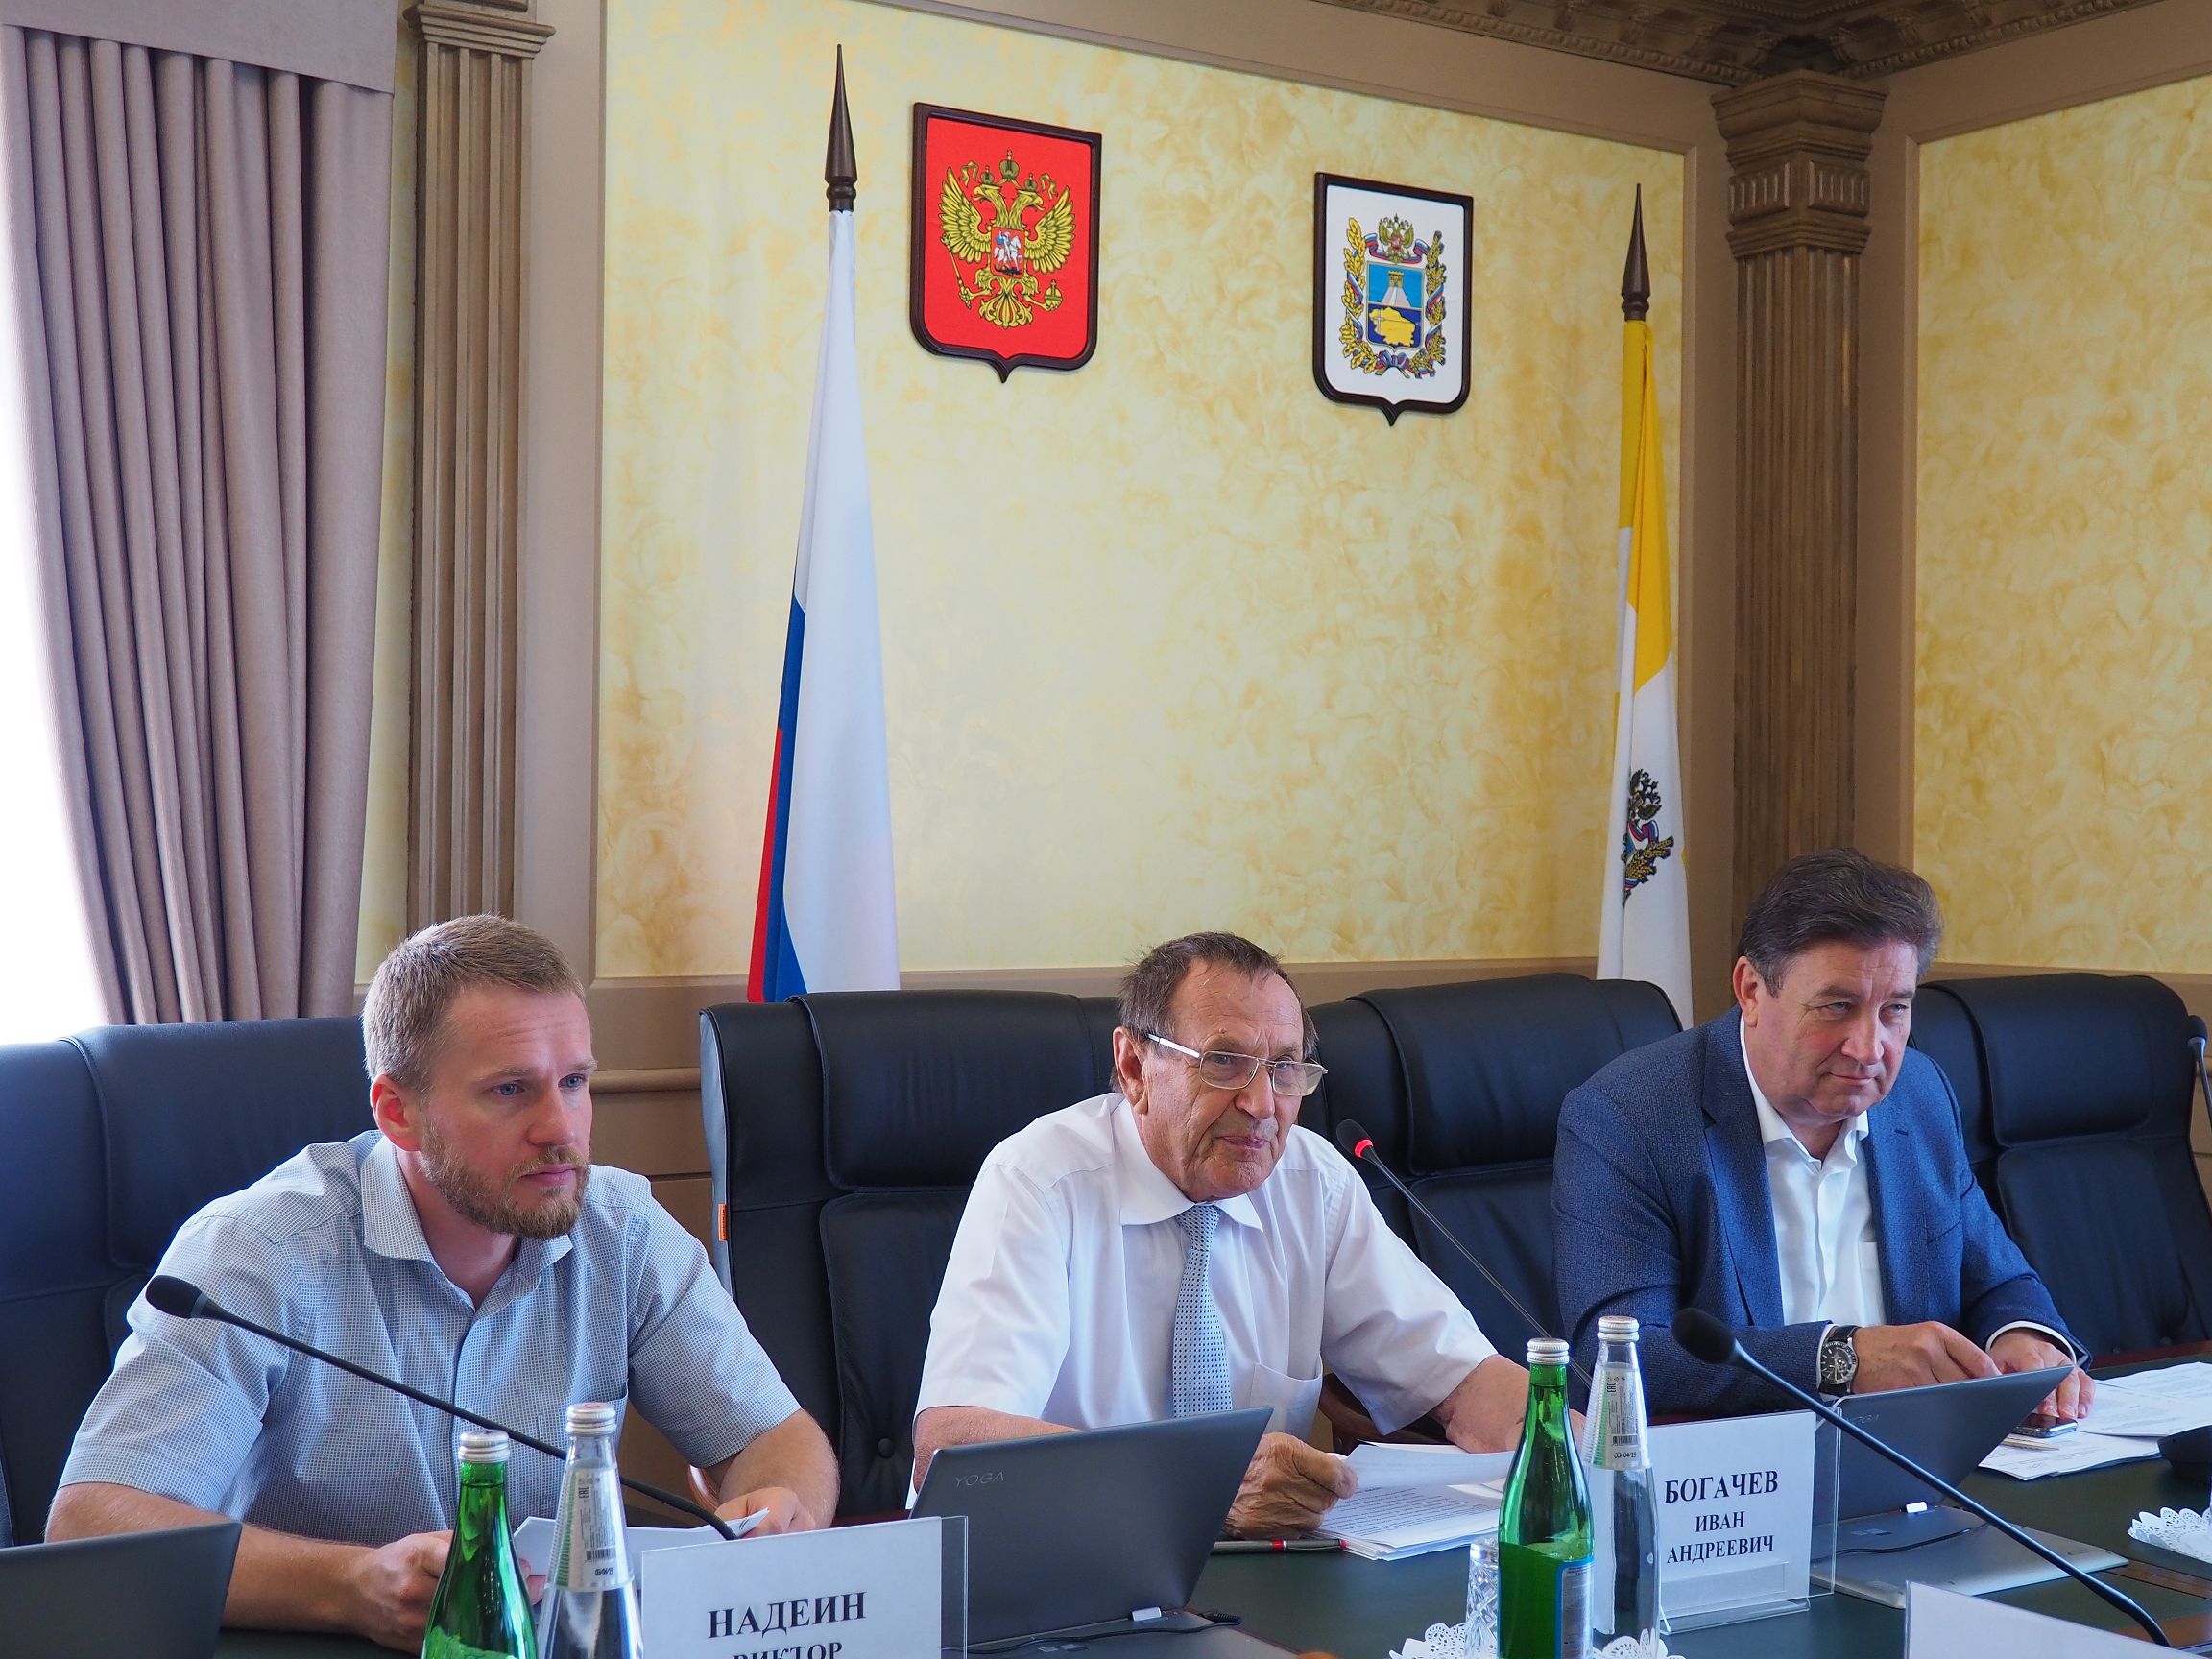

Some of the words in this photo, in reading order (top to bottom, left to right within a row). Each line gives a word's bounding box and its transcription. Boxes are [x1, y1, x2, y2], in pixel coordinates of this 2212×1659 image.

[955, 1471, 1004, 1488] YOGA
[1664, 1470, 1778, 1503] БОГАЧЕВ
[1695, 1510, 1745, 1533] ИВАН
[1667, 1535, 1774, 1564] АНДРЕЕВИЧ
[708, 1591, 867, 1639] НАДЕИН
[733, 1642, 843, 1659] КТОР
